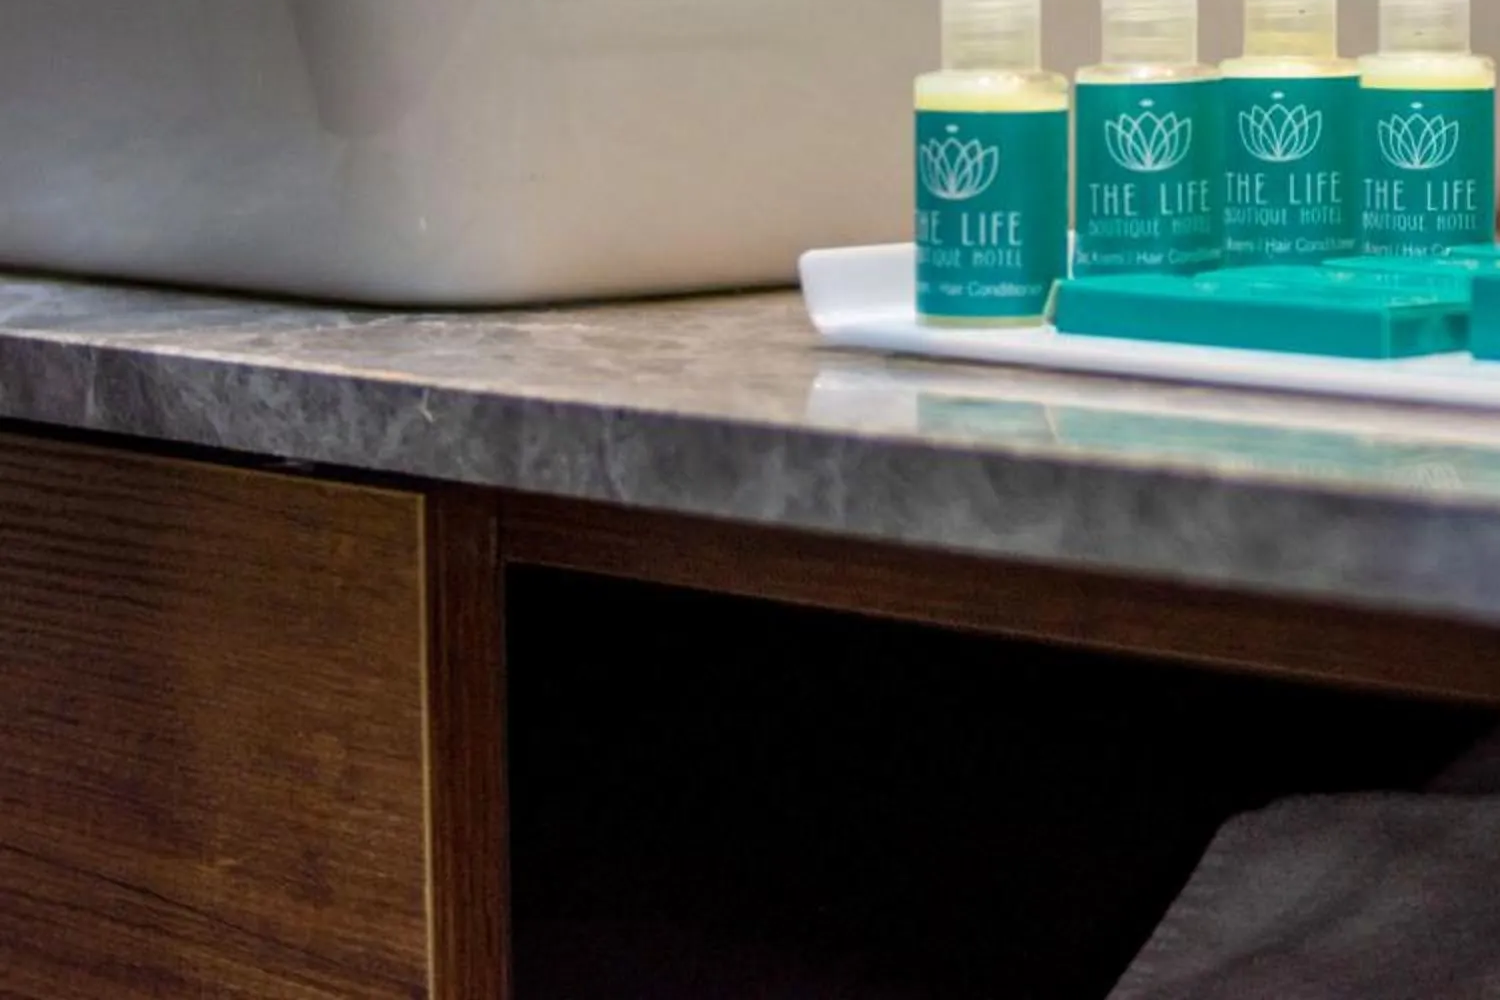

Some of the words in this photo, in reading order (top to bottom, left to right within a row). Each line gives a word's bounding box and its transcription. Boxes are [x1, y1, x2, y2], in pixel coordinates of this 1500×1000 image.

[1089, 182, 1138, 216] THE
[1160, 180, 1211, 215] LIFE
[1224, 171, 1267, 205] THE
[1289, 171, 1342, 205] LIFE
[1362, 178, 1406, 211] THE
[1426, 179, 1477, 211] LIFE
[960, 211, 1022, 247] LIFE
[1088, 217, 1160, 239] BOUTIQUE
[1224, 205, 1287, 227] BOUTIQUE
[1300, 205, 1342, 226] HOTEL
[1362, 210, 1424, 232] BOUTIQUE
[1437, 213, 1477, 232] HOTEL
[972, 247, 1023, 269] HOTEL
